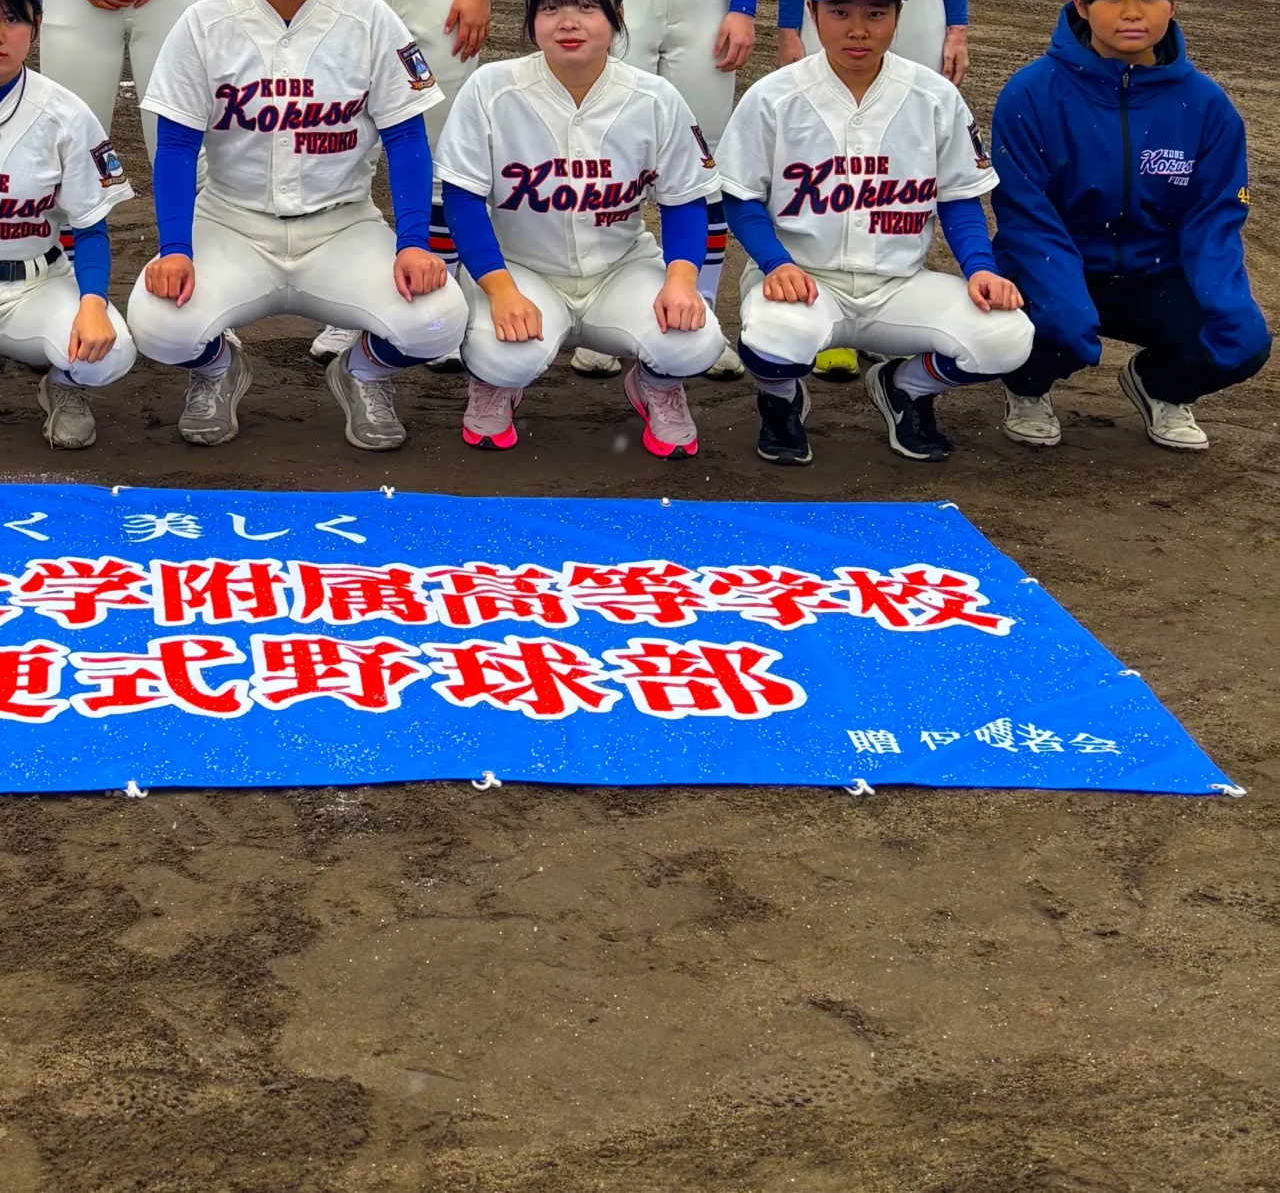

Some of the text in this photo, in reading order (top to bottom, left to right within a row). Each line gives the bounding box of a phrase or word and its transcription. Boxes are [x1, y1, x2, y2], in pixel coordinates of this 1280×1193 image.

[260, 78, 314, 98] KOBE
[294, 128, 358, 154] FUZOKU
[553, 158, 612, 179] KOBE
[834, 156, 889, 175] KOBE
[1140, 149, 1196, 175] Kokus
[777, 158, 937, 217] Kokusa
[122, 512, 367, 544] 美しく
